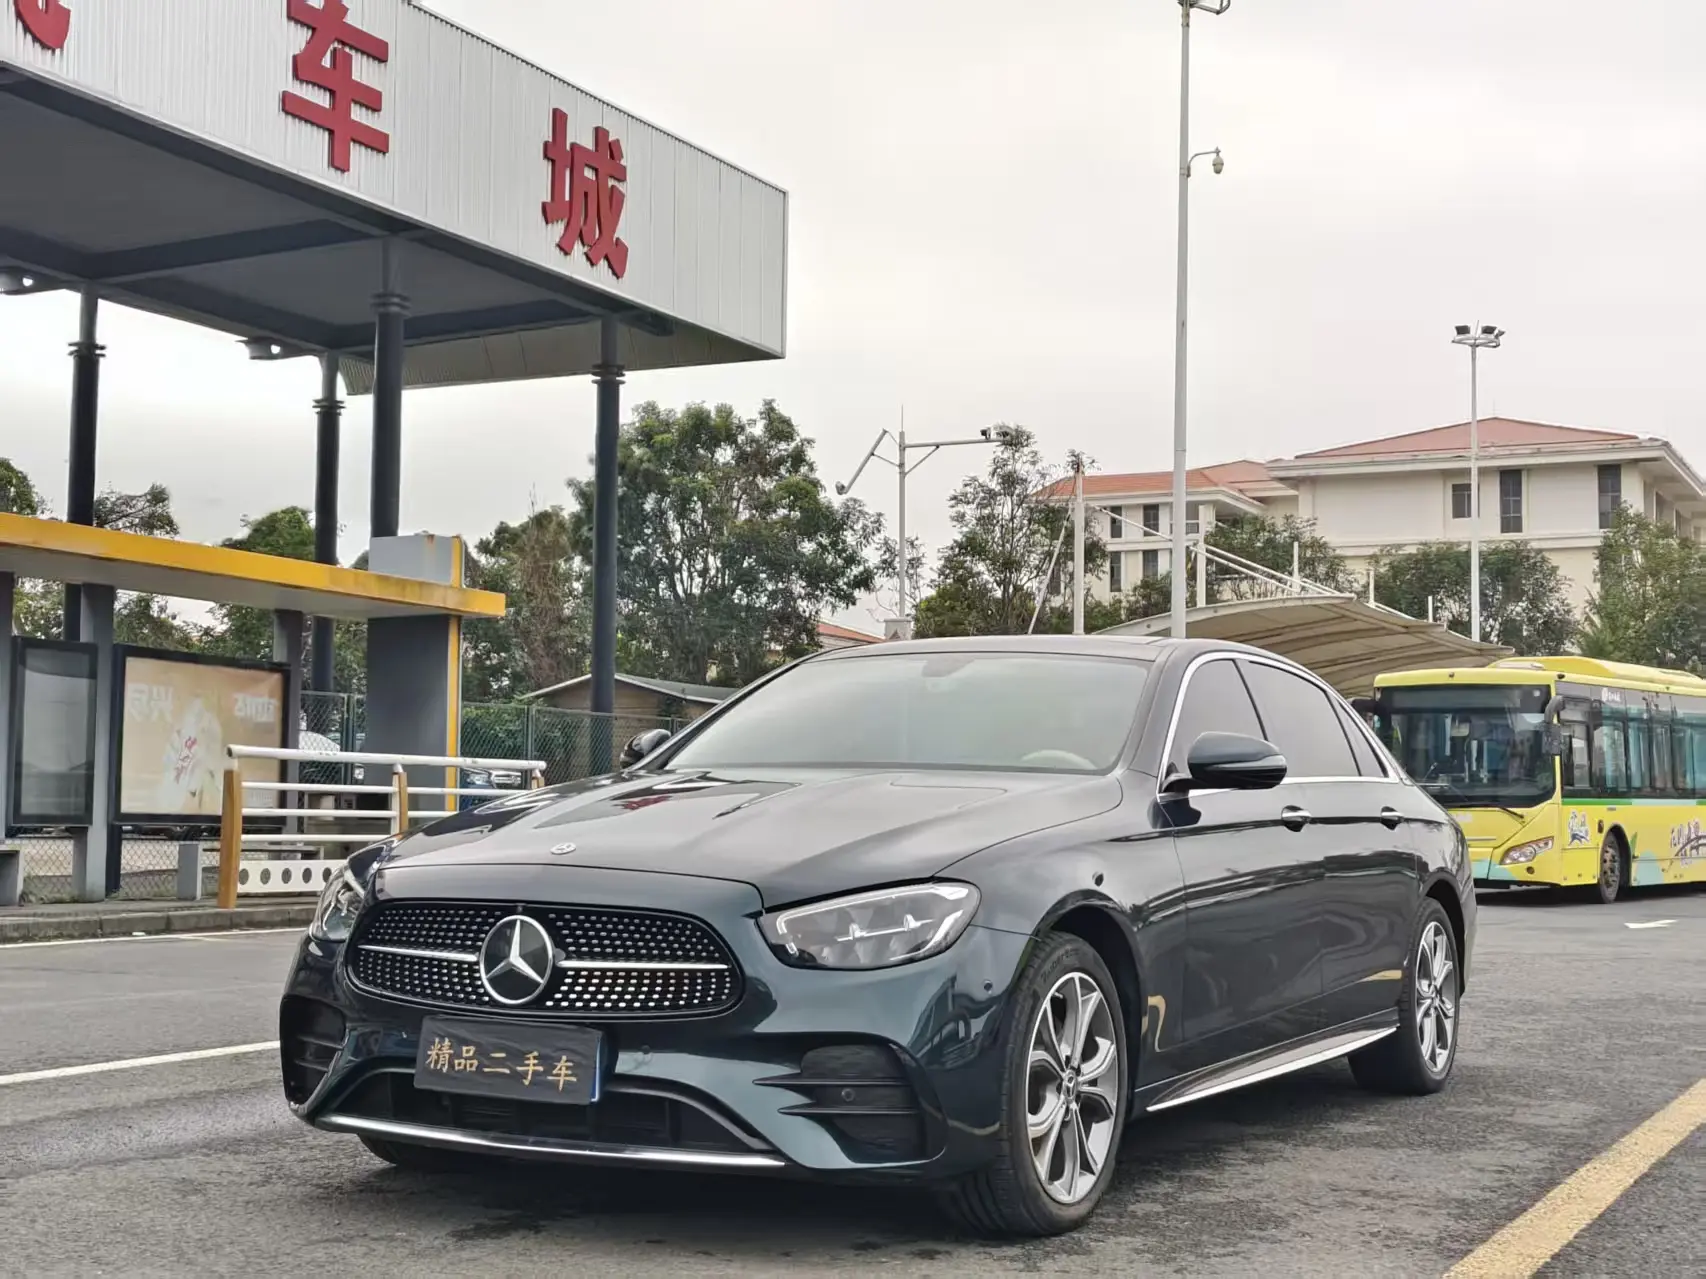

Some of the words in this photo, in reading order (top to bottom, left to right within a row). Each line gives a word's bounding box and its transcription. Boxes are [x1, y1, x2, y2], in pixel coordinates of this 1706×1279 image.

[425, 1036, 578, 1093] 精品二手车
